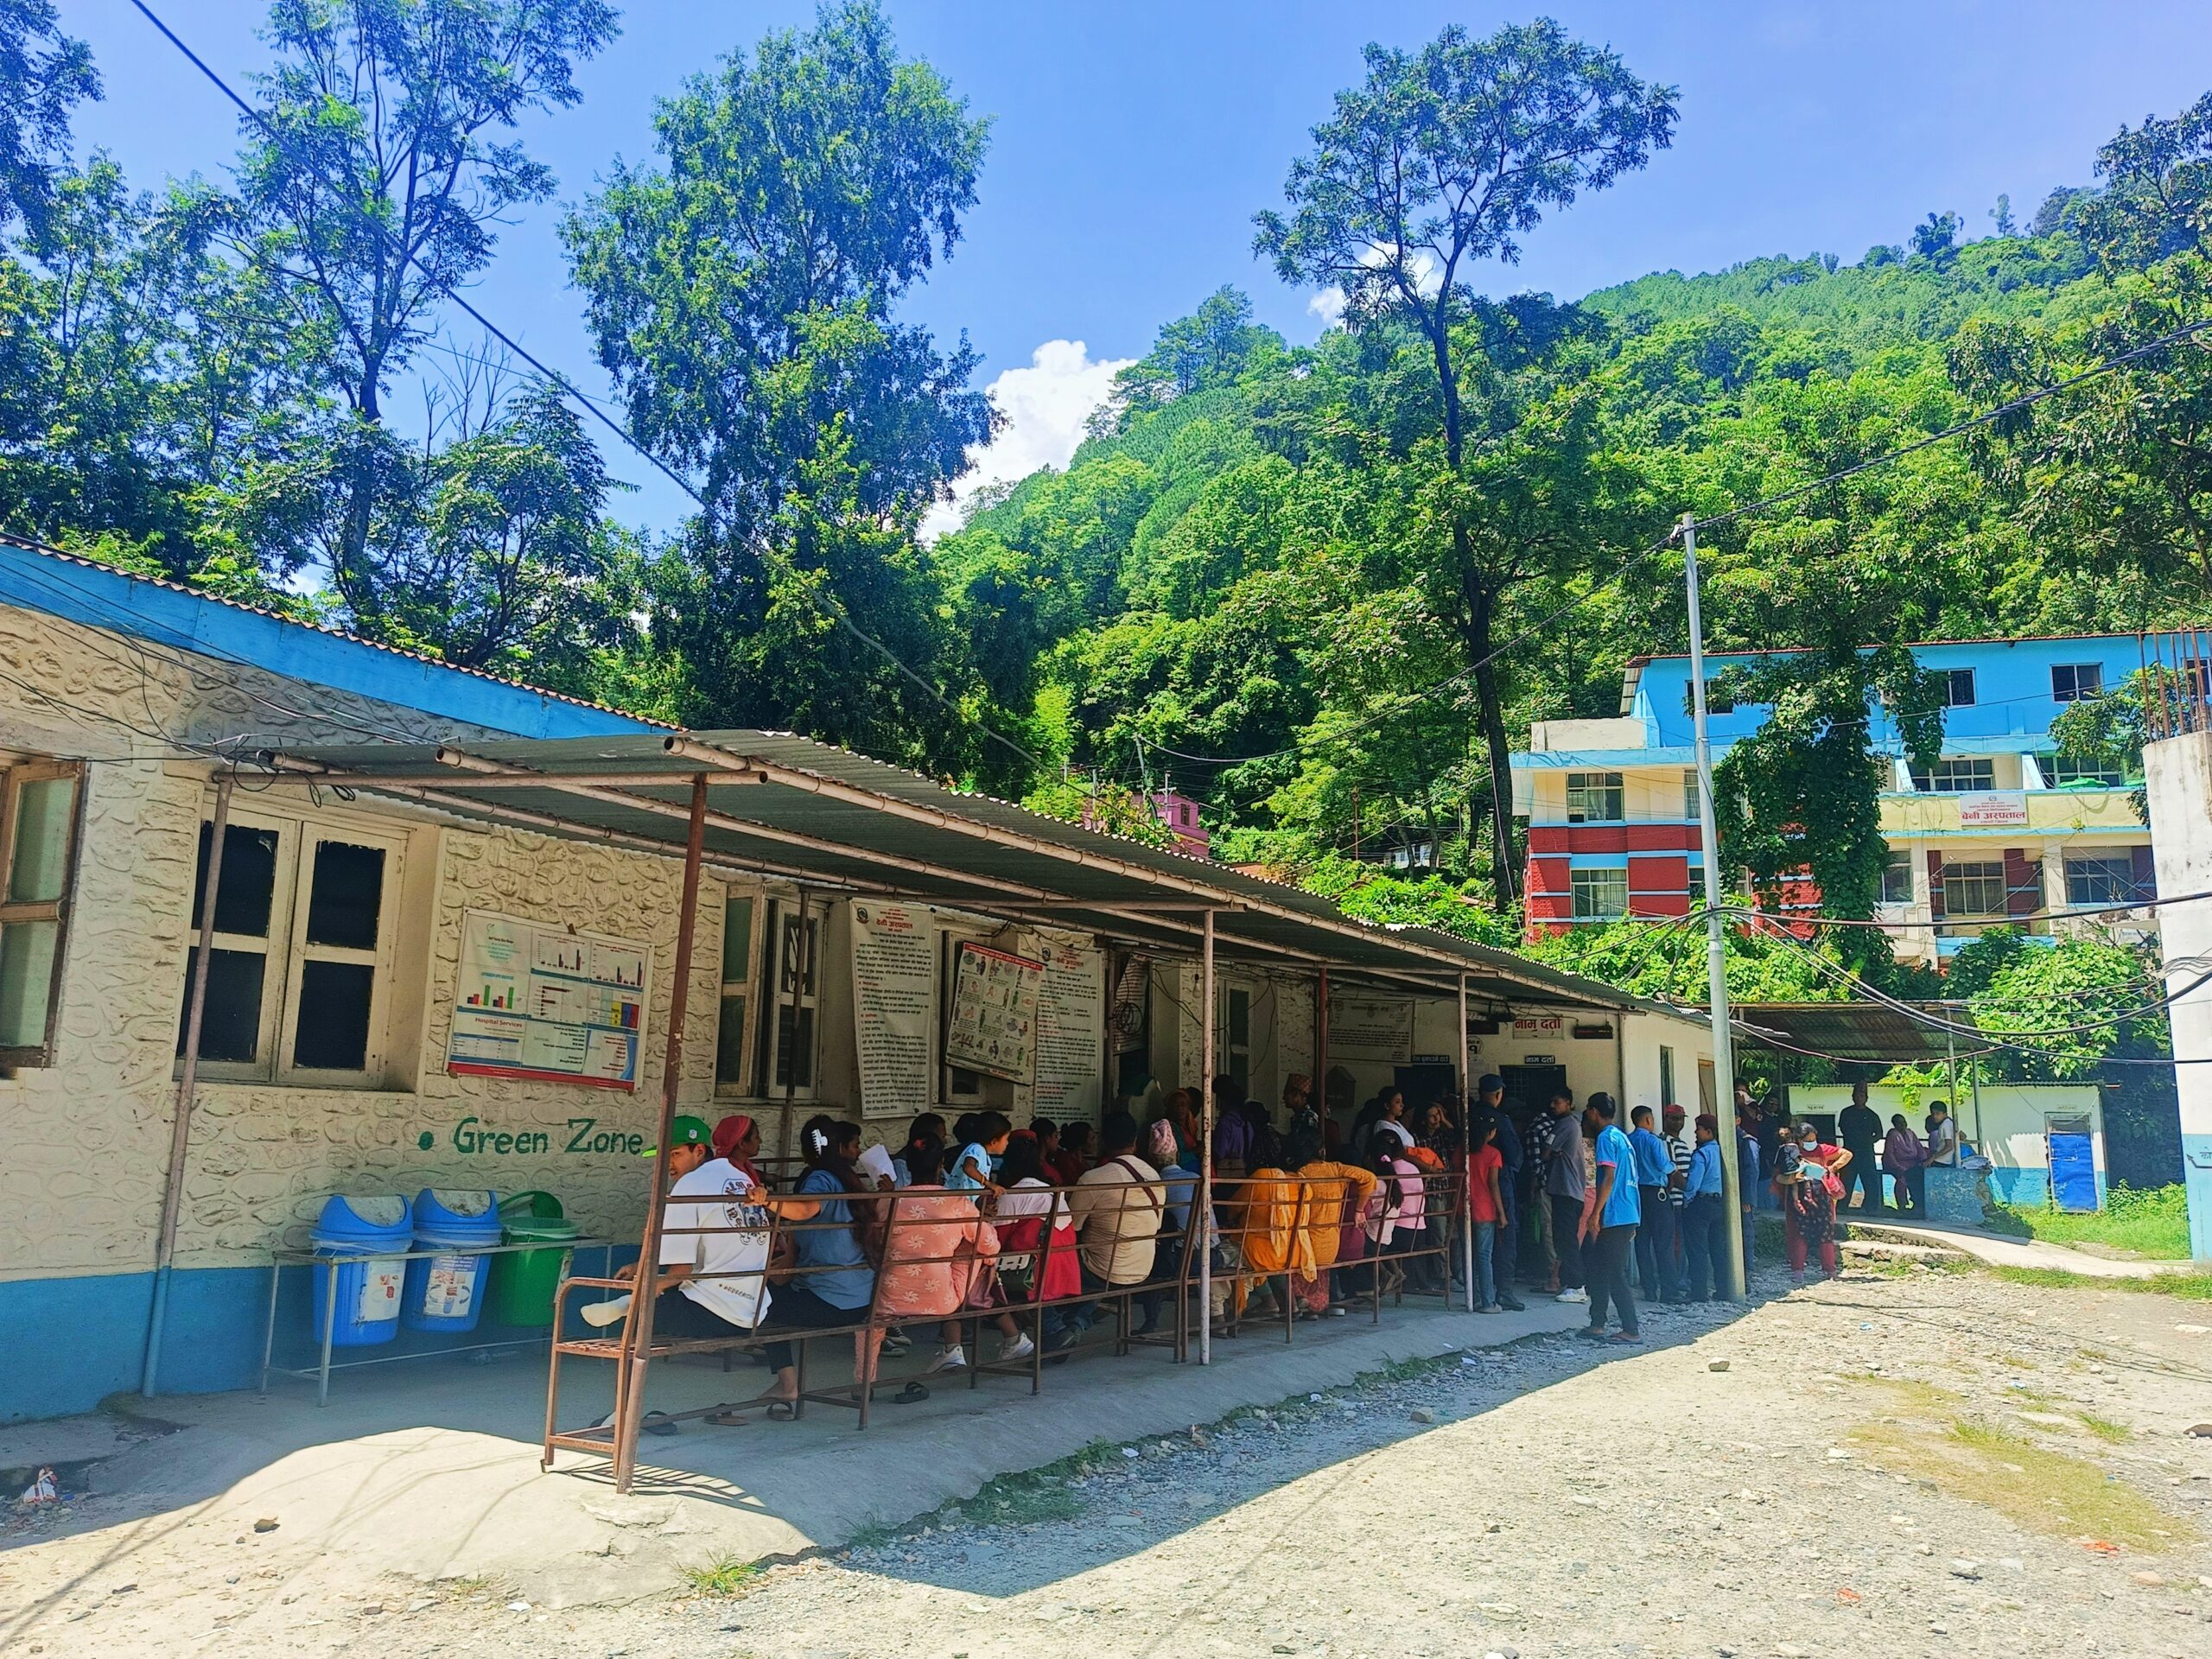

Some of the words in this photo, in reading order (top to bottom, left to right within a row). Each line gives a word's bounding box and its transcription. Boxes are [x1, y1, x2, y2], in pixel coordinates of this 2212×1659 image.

[474, 1016, 499, 1026] Hospital
[499, 1020, 523, 1028] Services
[1514, 1018, 1537, 1030] नाम
[453, 1116, 549, 1155] Green
[564, 1118, 644, 1155] Zone
